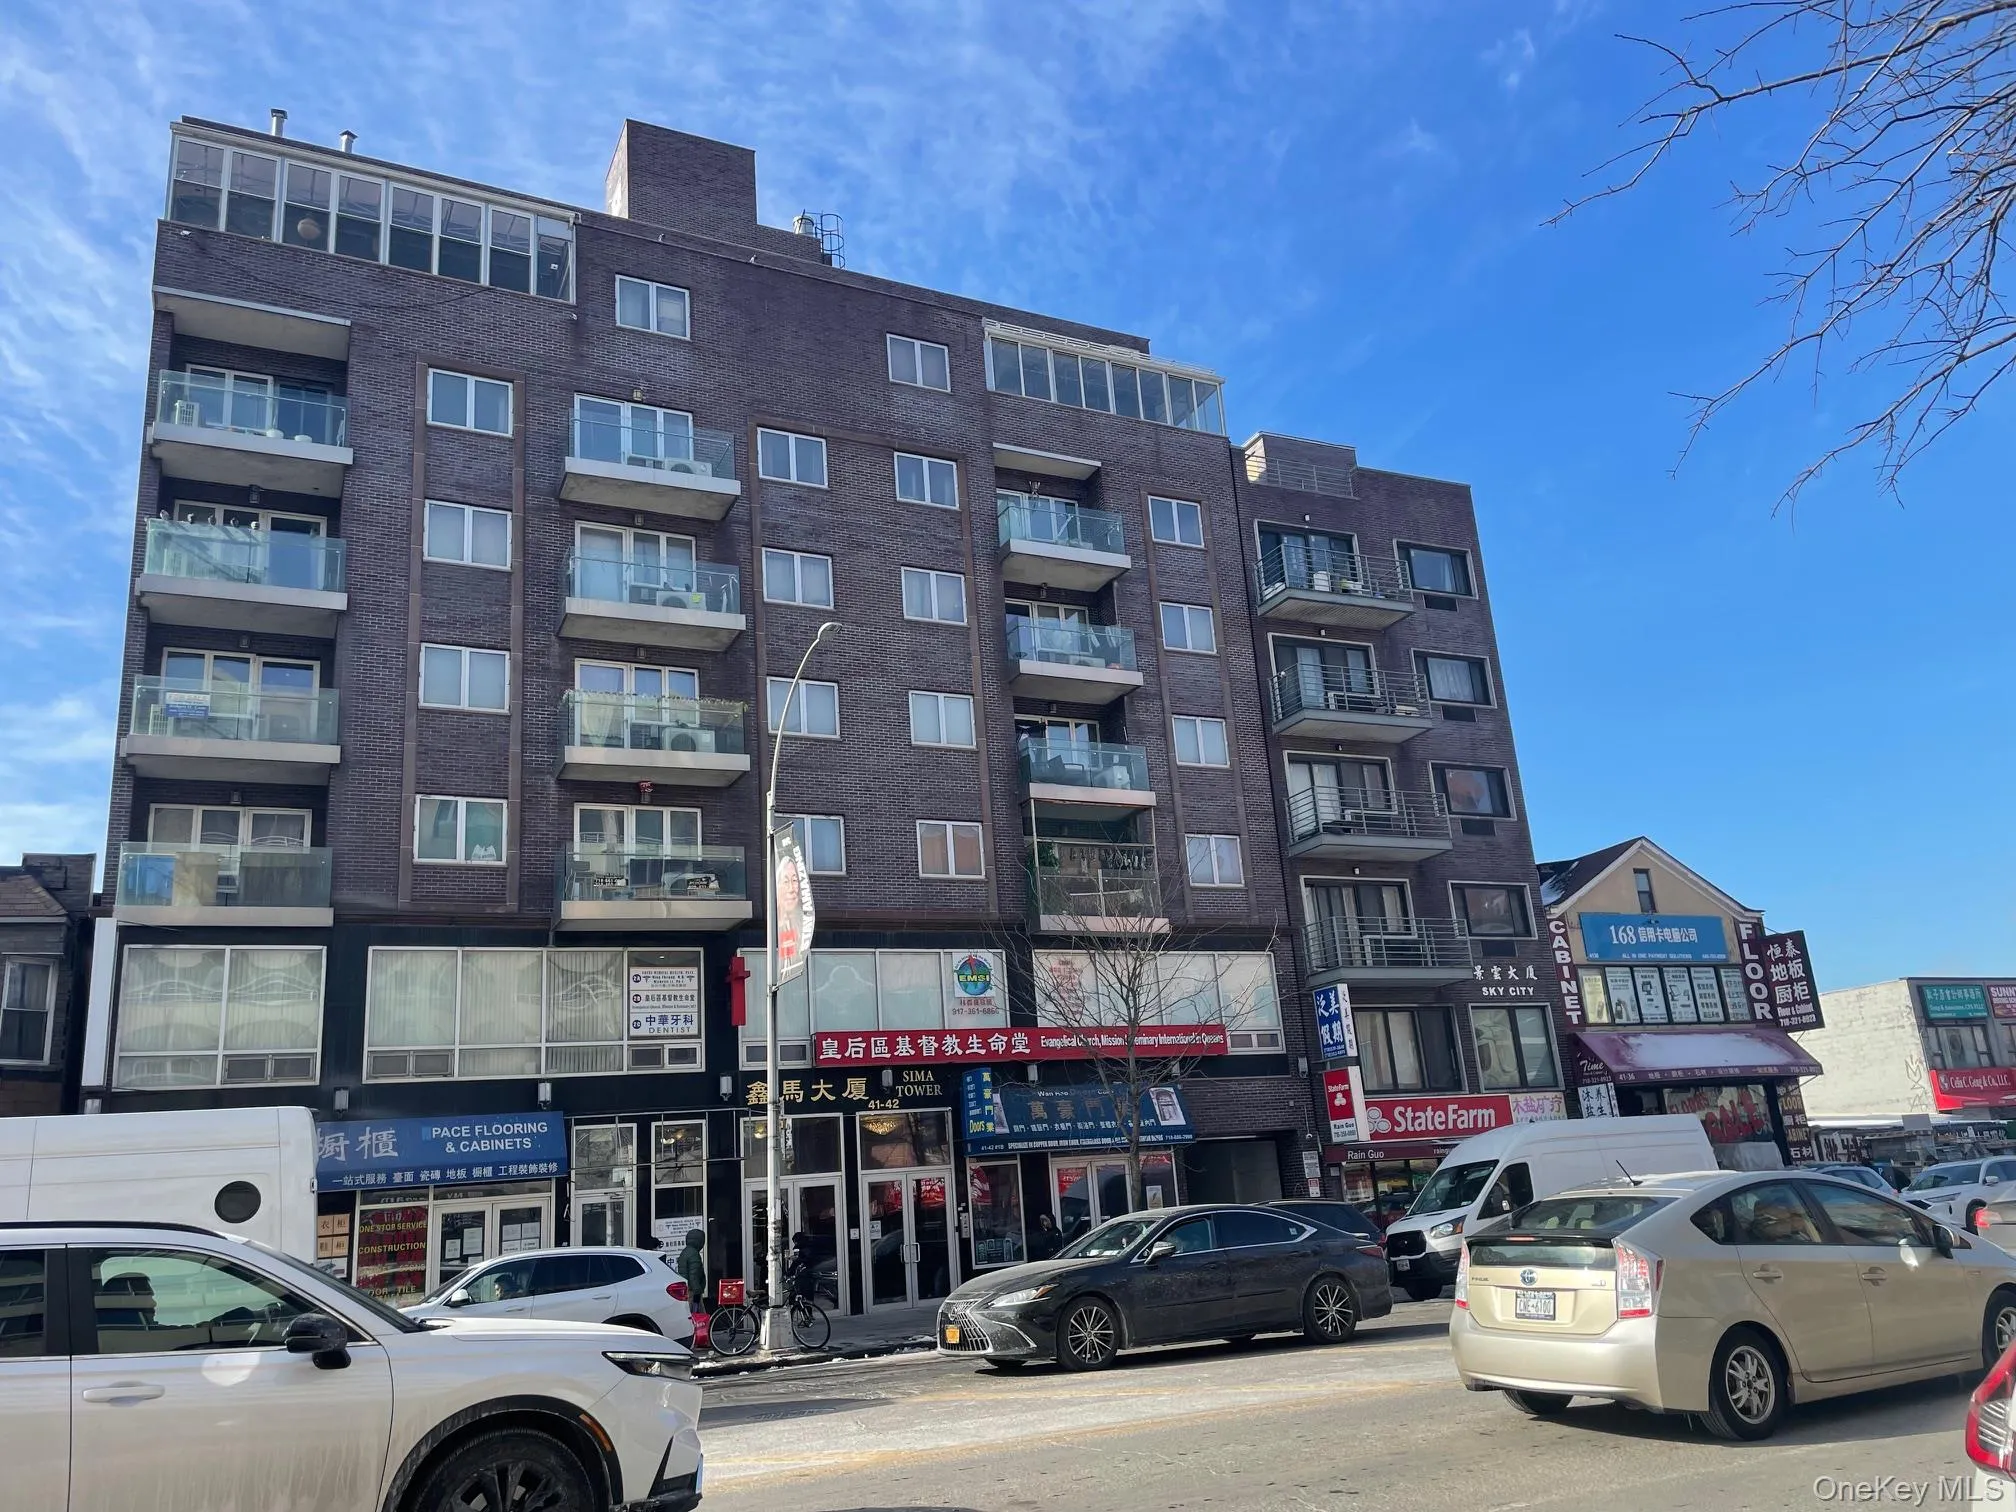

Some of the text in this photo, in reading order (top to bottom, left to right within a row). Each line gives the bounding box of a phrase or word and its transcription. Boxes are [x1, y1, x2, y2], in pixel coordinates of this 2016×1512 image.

[1610, 925, 1636, 945] 168
[1549, 921, 1581, 1025] CABINET
[1739, 923, 1773, 1020] FLOOR
[1770, 959, 1806, 982] 地板
[1482, 986, 1534, 996] SKY CITY
[646, 1014, 694, 1026] 中華牙科
[820, 1032, 1031, 1059] 皇后區基督教生命堂
[1041, 1035, 1077, 1050] Evangelical
[1102, 1033, 1125, 1046] Mission
[1580, 1059, 1604, 1072] Time
[903, 1070, 935, 1083] SIMA
[895, 1084, 943, 1097] TOWER
[868, 1099, 900, 1109] 41-42
[432, 1122, 548, 1139] PACE FLOORING
[445, 1137, 532, 1153] & CABINETS
[1348, 1149, 1385, 1160] Rain Guo
[1790, 1146, 1813, 1159] 石材
[332, 1172, 387, 1186] 一站式服務
[446, 1168, 467, 1180] 地板
[396, 1220, 428, 1231] SERVICE
[358, 1242, 427, 1255] CONSTRUCTION
